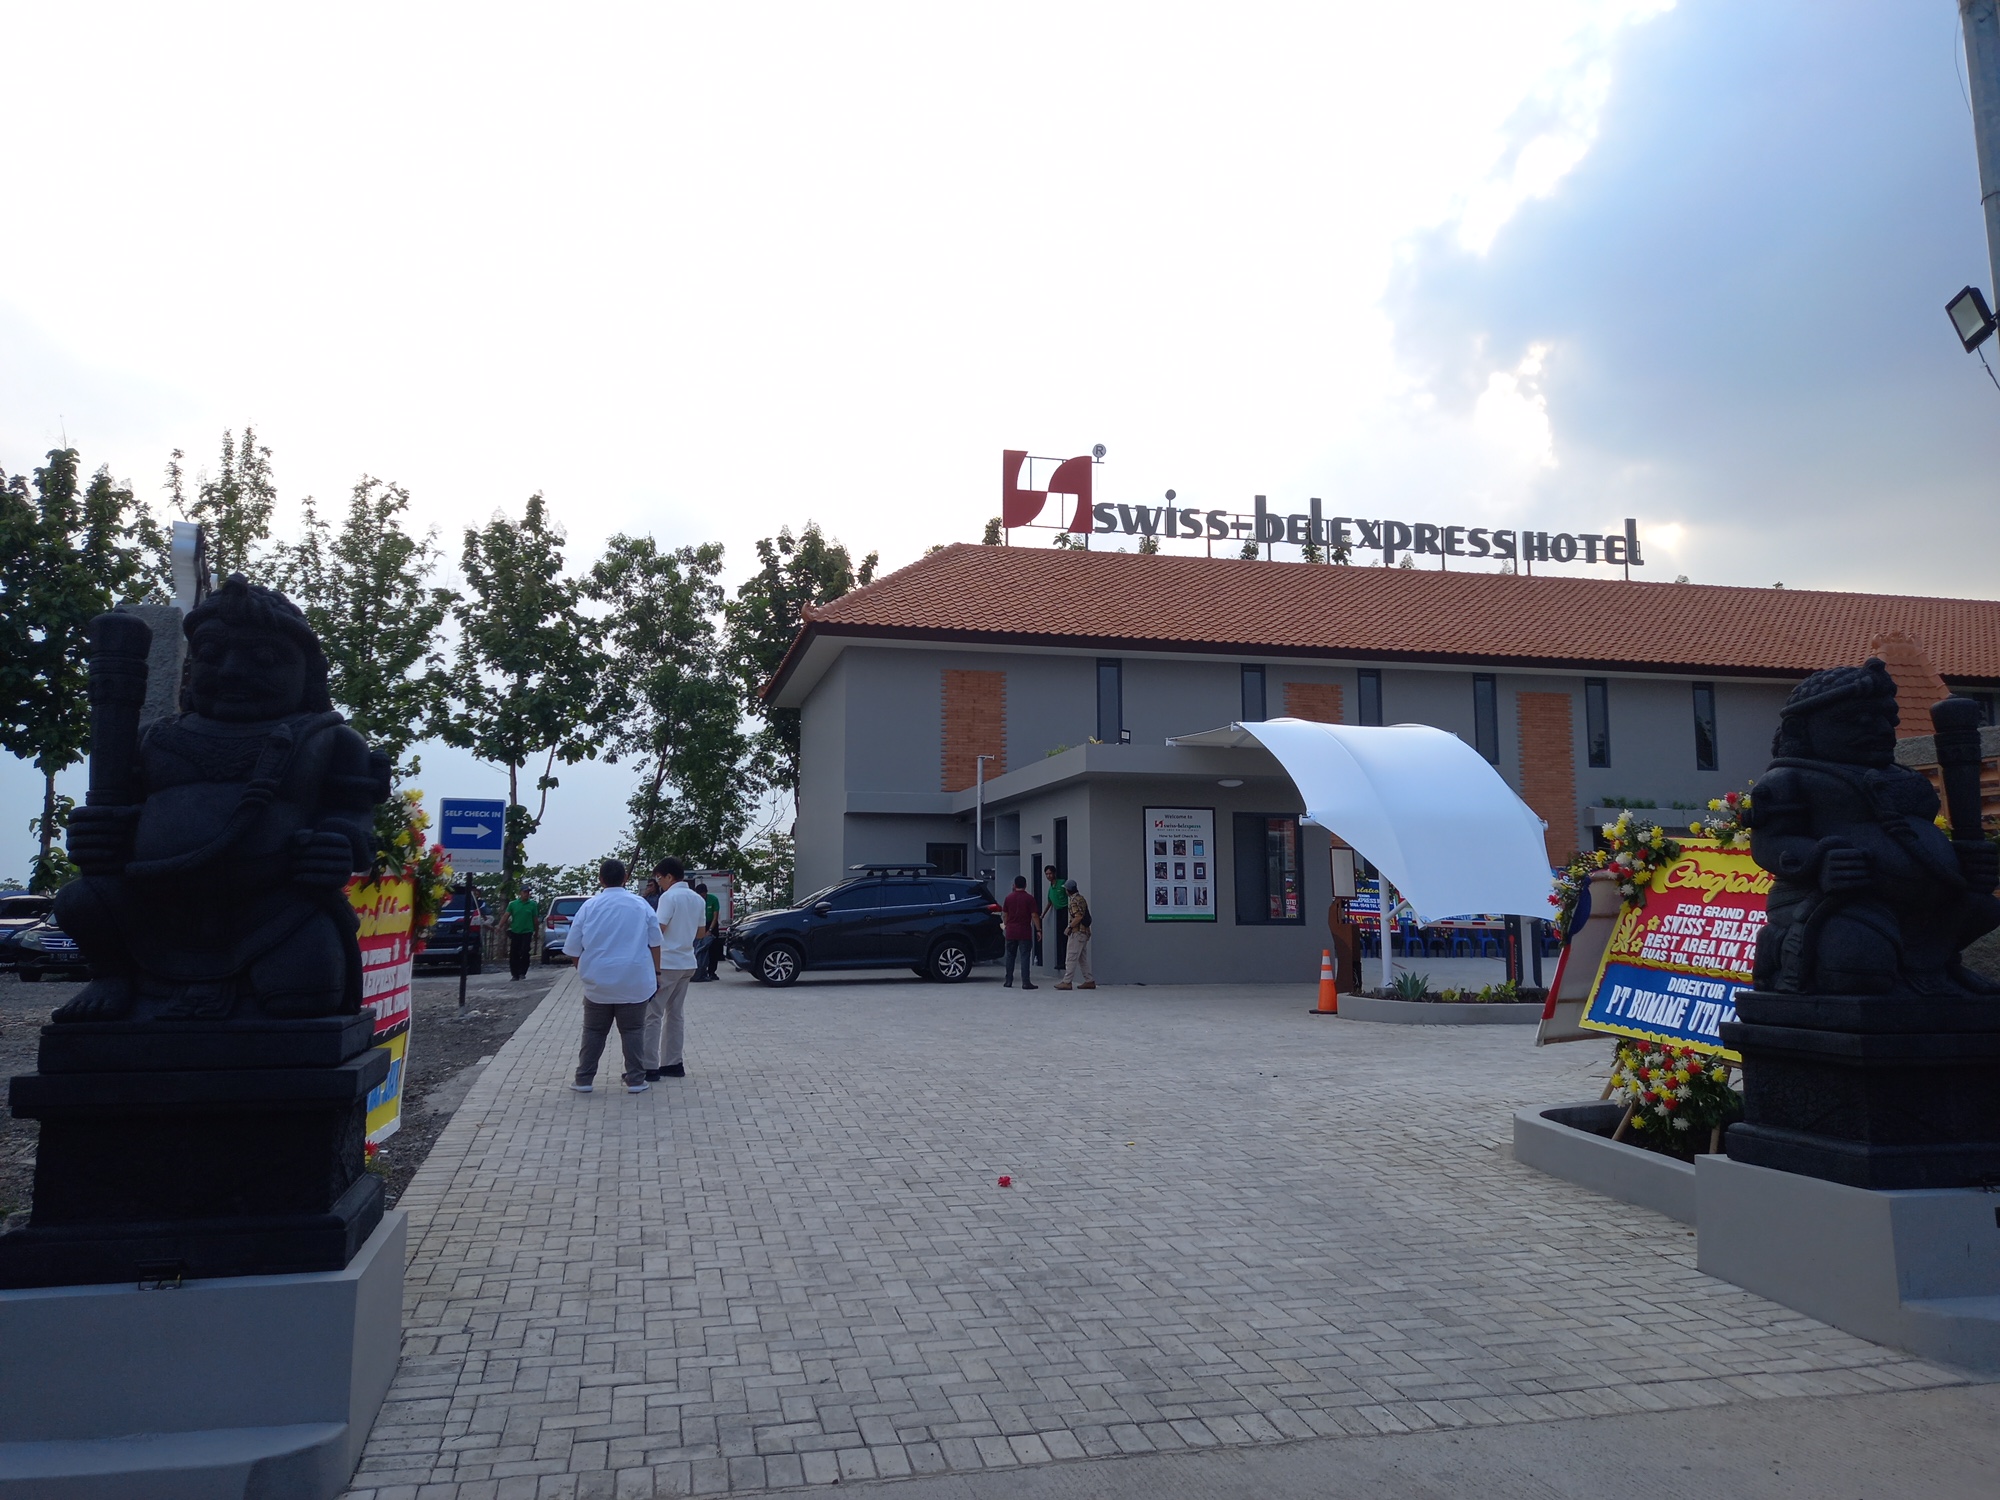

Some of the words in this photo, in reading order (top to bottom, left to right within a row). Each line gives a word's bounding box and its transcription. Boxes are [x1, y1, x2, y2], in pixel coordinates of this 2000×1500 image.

[444, 809, 463, 817] SELF
[464, 810, 490, 818] CHECK
[1676, 903, 1703, 917] FOR
[1703, 905, 1745, 920] GRAND
[1661, 915, 1764, 943] SWISS-BELEX
[1643, 932, 1680, 951] REST
[1680, 937, 1717, 955] AREA
[1718, 941, 1743, 959] KM
[1640, 947, 1668, 961] RUAS
[1670, 951, 1690, 965] TOL
[1691, 955, 1728, 970] CIPALI
[1666, 976, 1727, 1000] DIREKTUR
[1605, 984, 1632, 1016] PT
[1687, 999, 1742, 1038] UTAM
